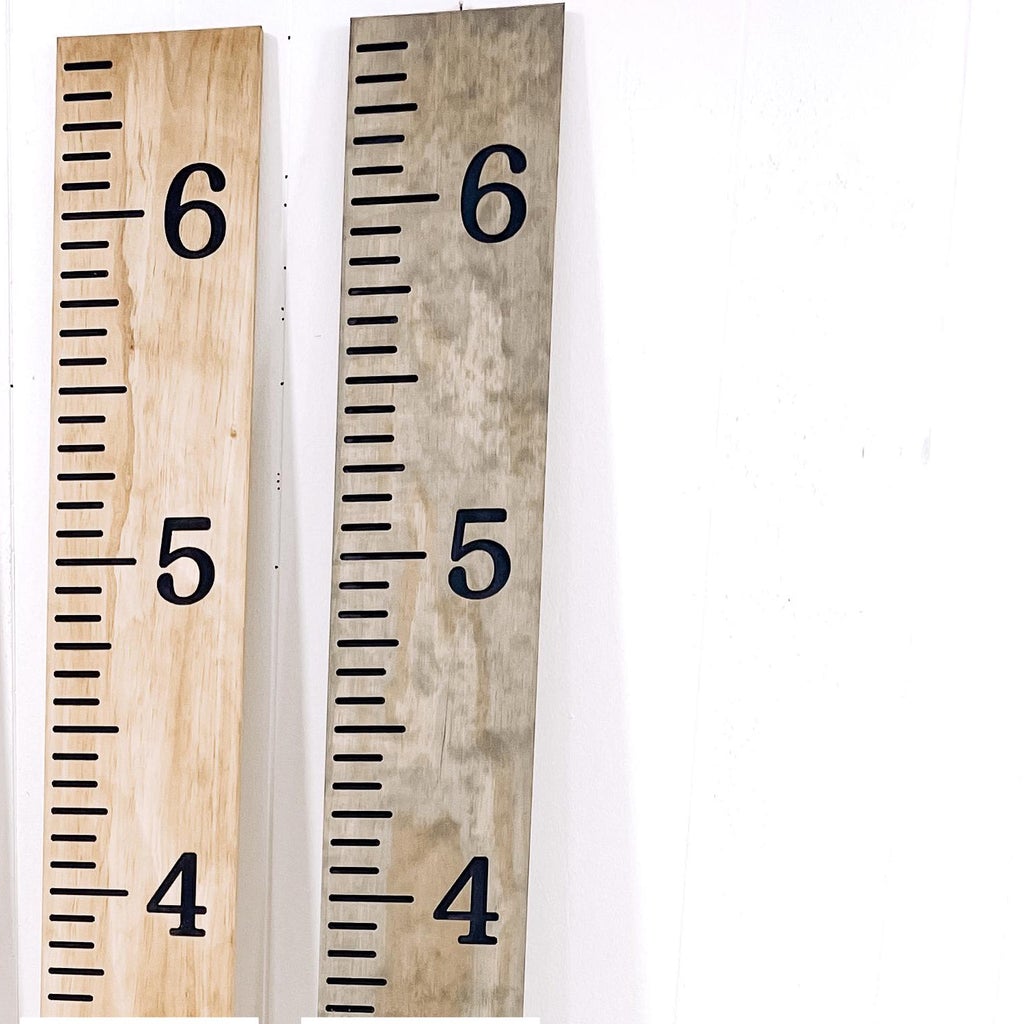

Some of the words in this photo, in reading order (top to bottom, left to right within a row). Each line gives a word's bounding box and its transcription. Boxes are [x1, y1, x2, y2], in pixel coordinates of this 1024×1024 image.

[165, 163, 226, 259] 6
[461, 144, 526, 243] 6
[157, 517, 215, 605] 5
[448, 508, 511, 599] 5
[147, 853, 206, 937] 4
[433, 857, 499, 945] 4
